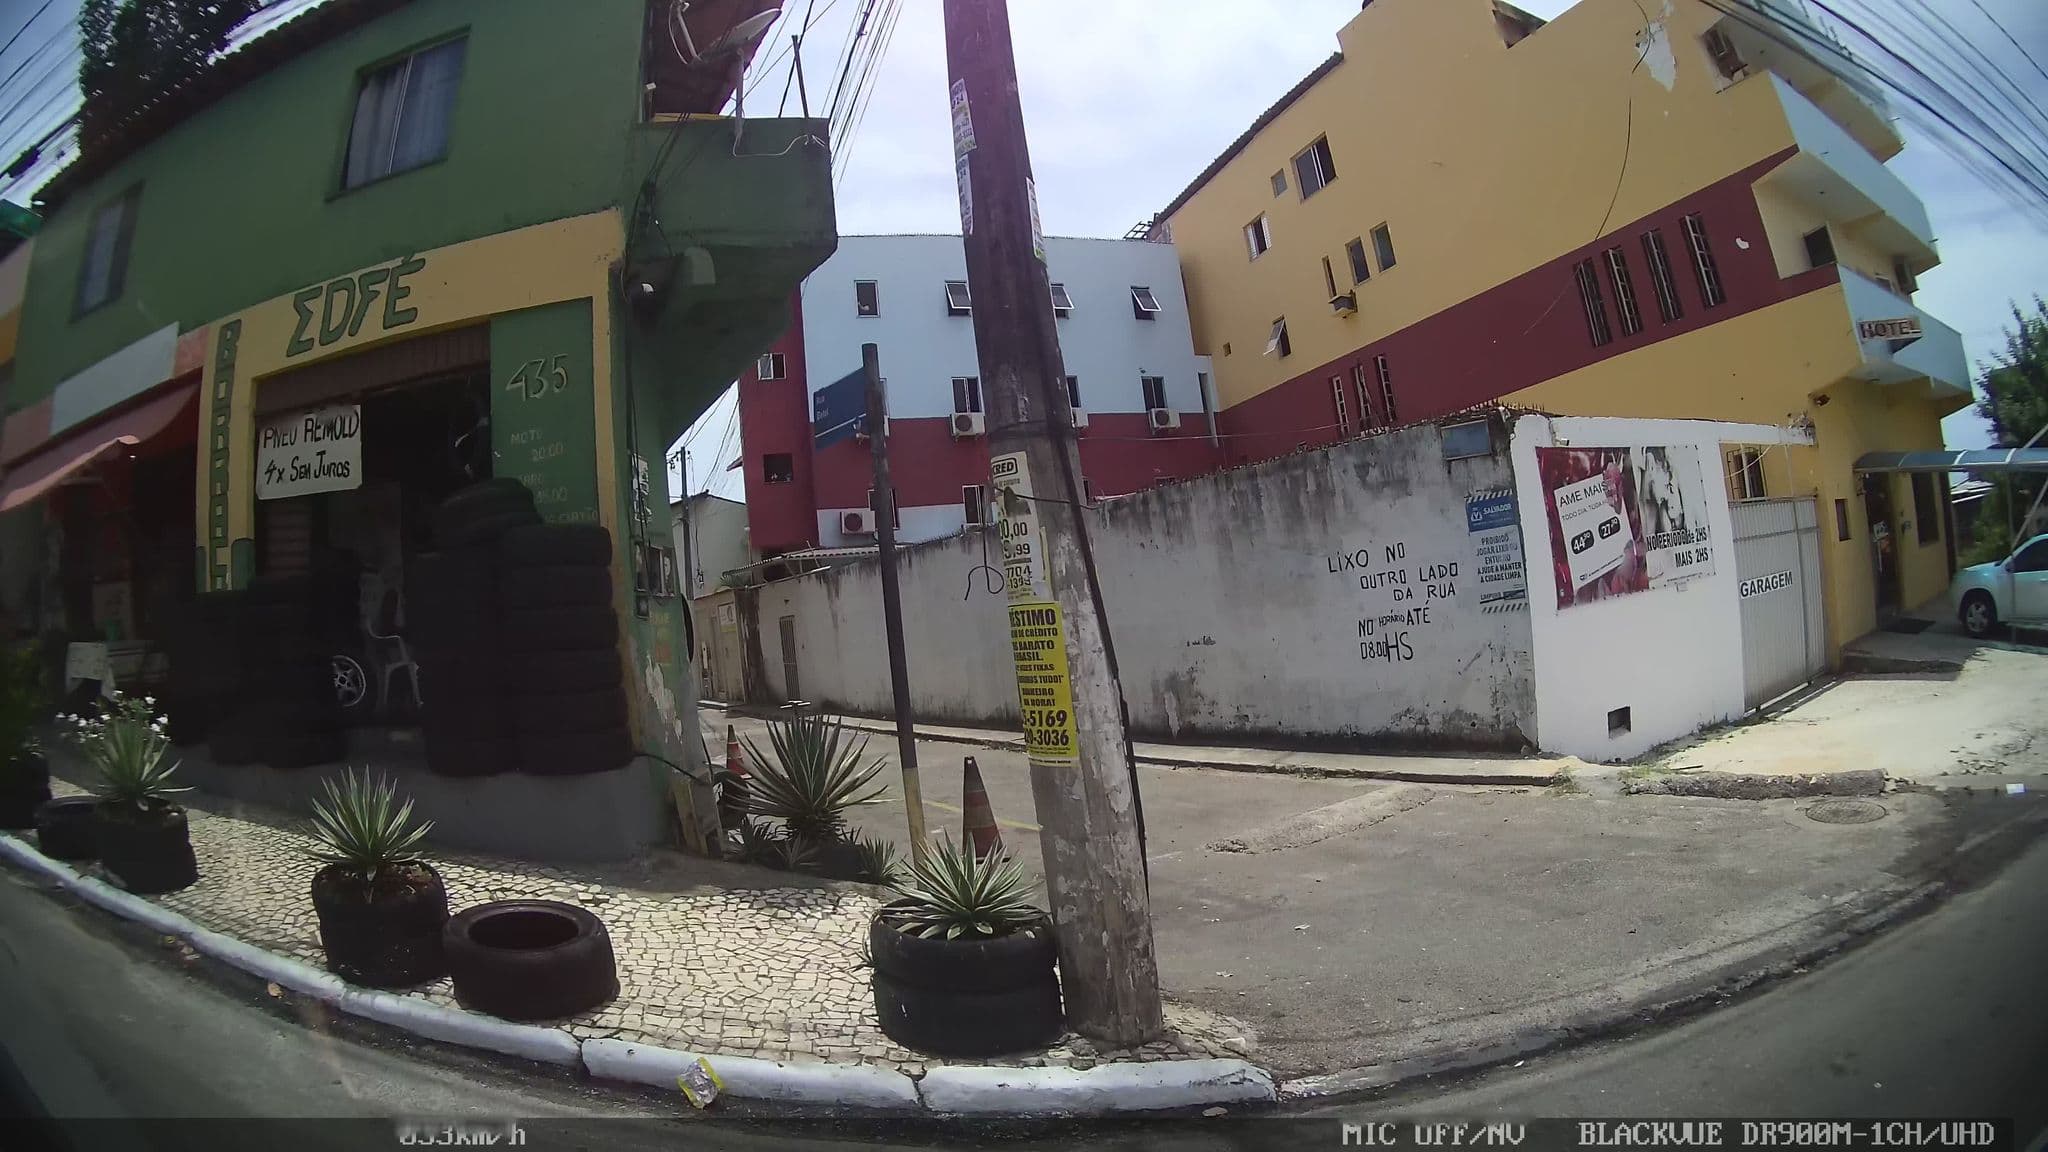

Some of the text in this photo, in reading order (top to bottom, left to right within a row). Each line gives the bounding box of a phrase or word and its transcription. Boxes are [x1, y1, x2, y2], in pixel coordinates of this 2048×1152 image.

[505, 353, 569, 401] 435
[263, 427, 298, 449] PNEU
[314, 450, 350, 479] JUROS
[1560, 480, 1609, 508] AME MAIS
[1385, 542, 1406, 563] NO
[1674, 550, 1693, 568] MAIS
[1360, 562, 1459, 590] OUTRO LADO
[1740, 571, 1793, 598] GARAGEM
[1393, 582, 1456, 601] DA RUA
[1358, 619, 1374, 638] NO
[1406, 600, 1431, 626] ATÉ
